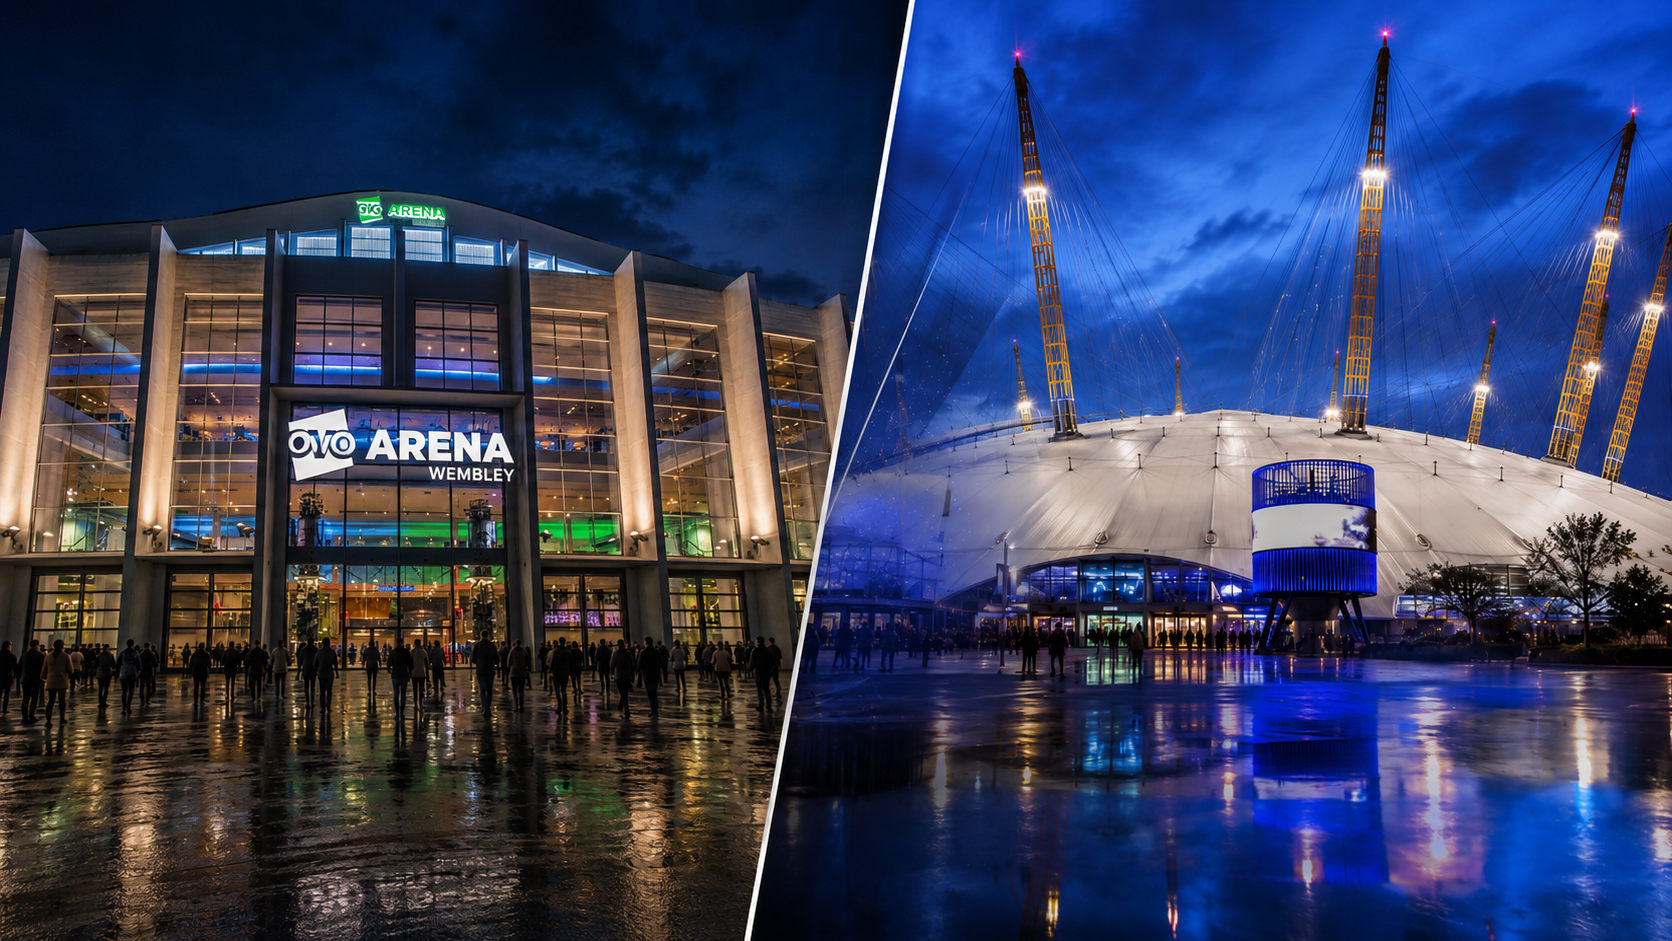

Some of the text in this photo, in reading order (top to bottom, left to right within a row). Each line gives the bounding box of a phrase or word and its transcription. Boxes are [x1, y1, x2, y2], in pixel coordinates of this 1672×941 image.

[387, 204, 446, 220] ARENA
[288, 429, 514, 463] OVO ARENA
[428, 466, 514, 482] WEMBLEY
